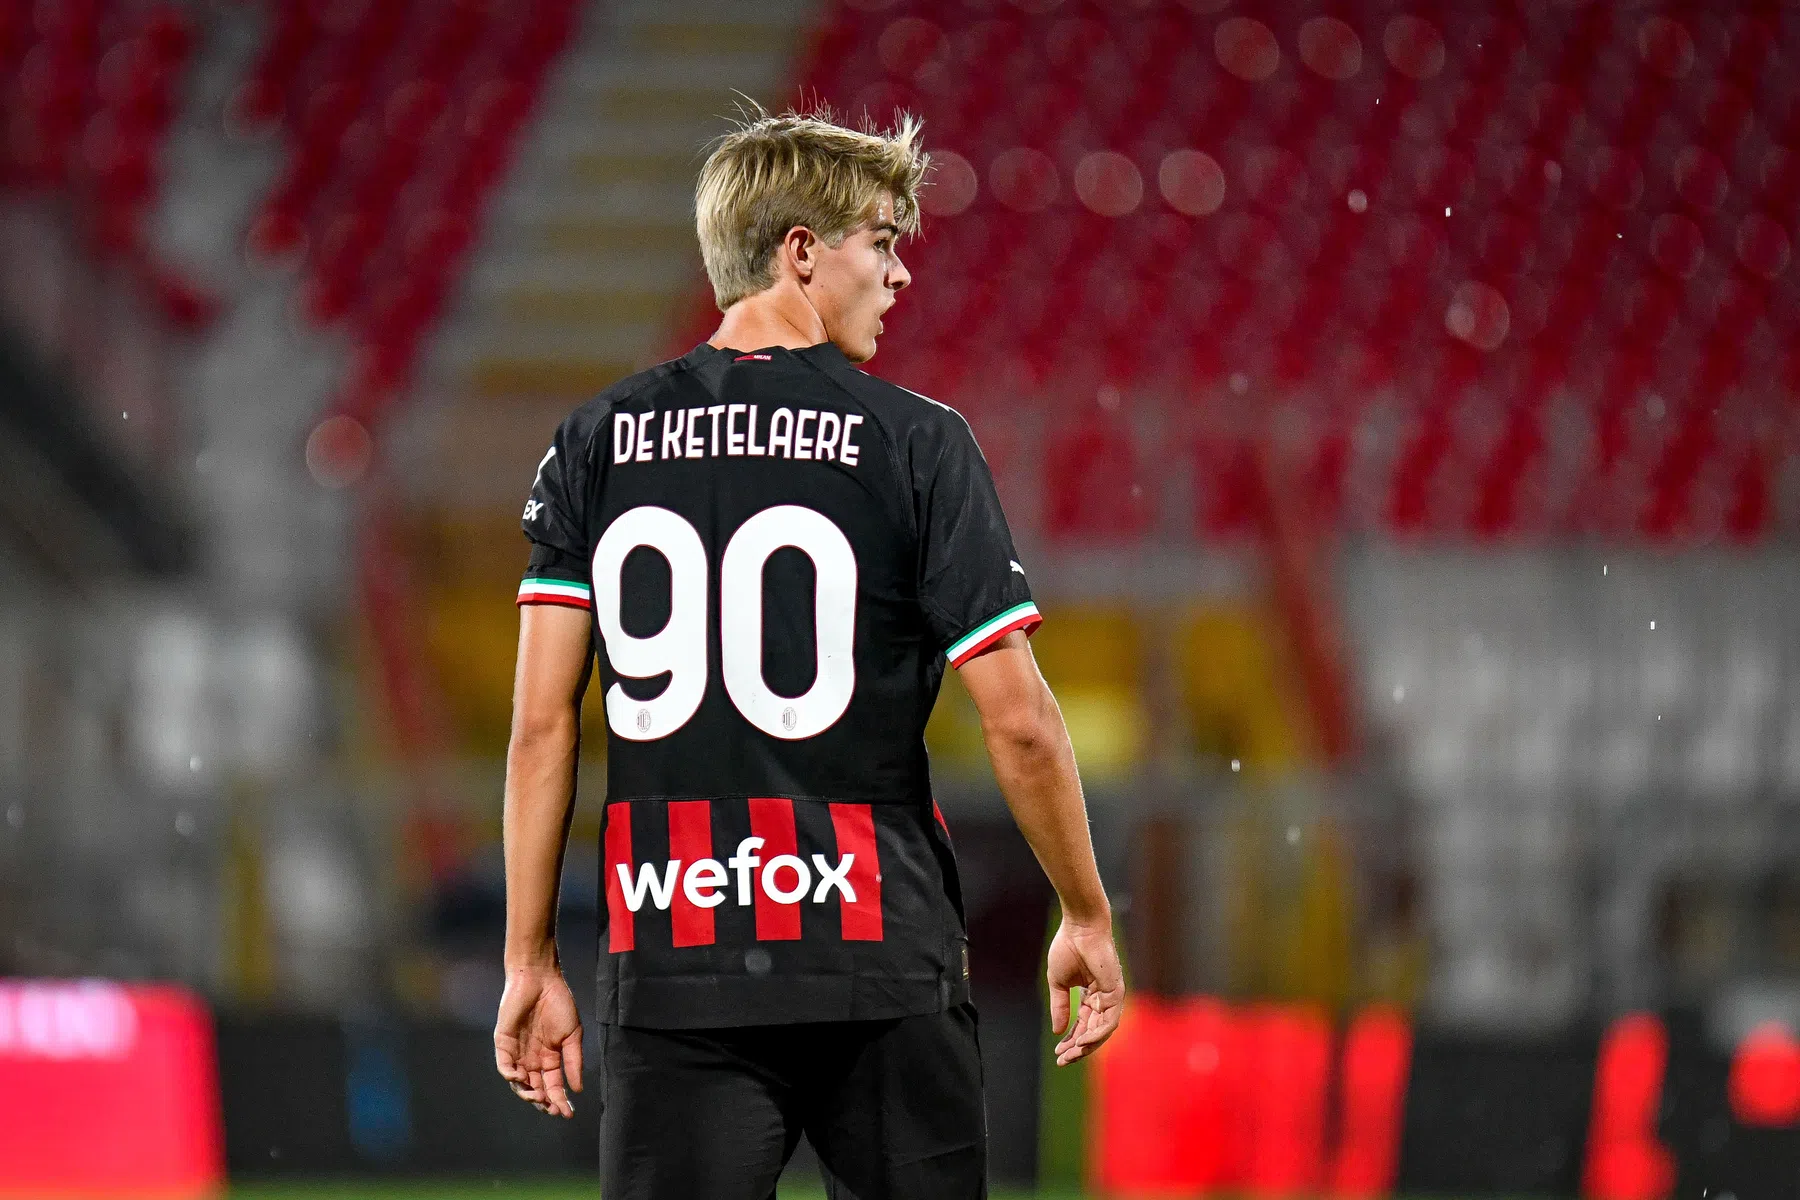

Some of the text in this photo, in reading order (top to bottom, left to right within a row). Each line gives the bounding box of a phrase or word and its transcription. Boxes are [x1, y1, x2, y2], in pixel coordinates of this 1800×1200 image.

[613, 403, 864, 467] DE KETELAERE
[591, 504, 858, 742] 90
[616, 836, 857, 912] wefox
